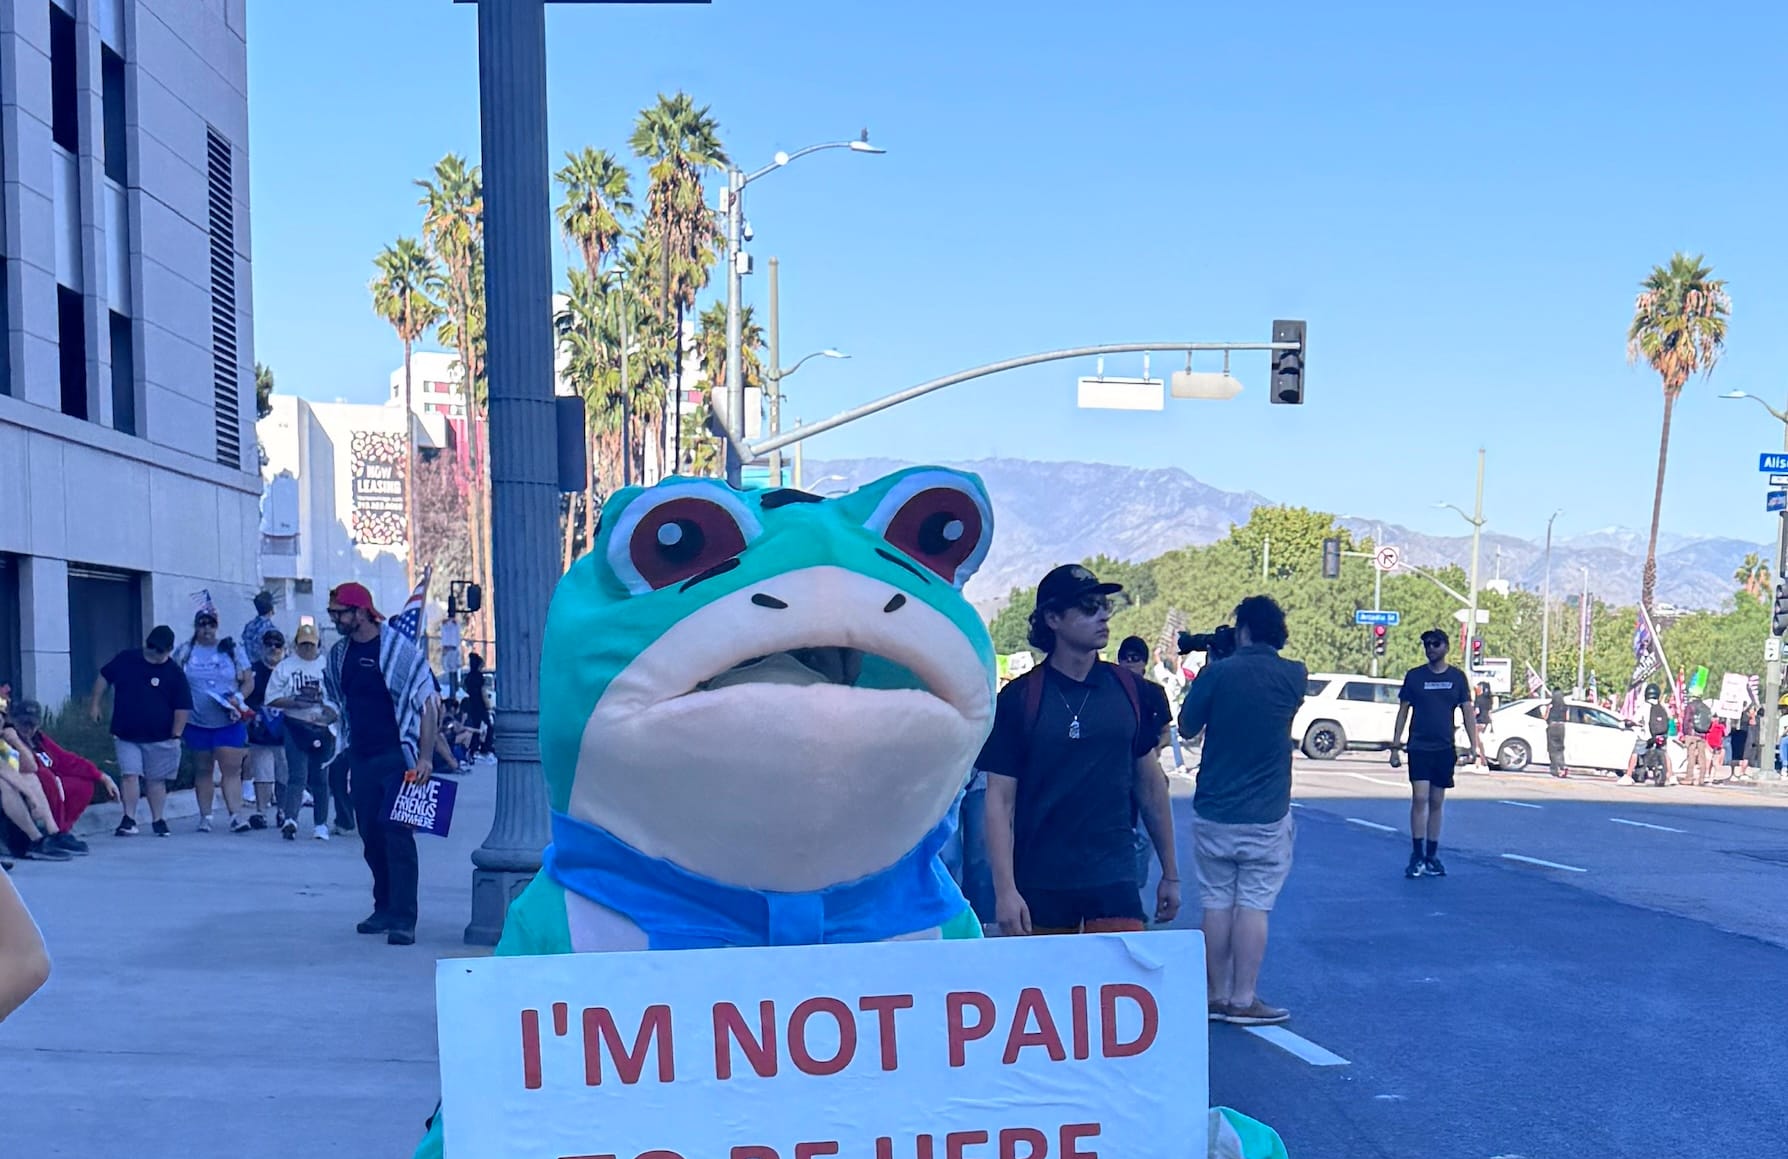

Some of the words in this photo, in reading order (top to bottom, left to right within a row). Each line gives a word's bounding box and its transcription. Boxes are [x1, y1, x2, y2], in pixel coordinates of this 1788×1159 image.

[366, 465, 392, 479] NOW
[356, 479, 402, 494] LEASING
[405, 780, 441, 803] HAVE
[393, 794, 437, 818] FRIENDS
[389, 808, 436, 830] EVERYWHERE
[521, 1002, 674, 1089] I'M
[713, 994, 913, 1080] NOT
[946, 984, 1158, 1067] PAID
